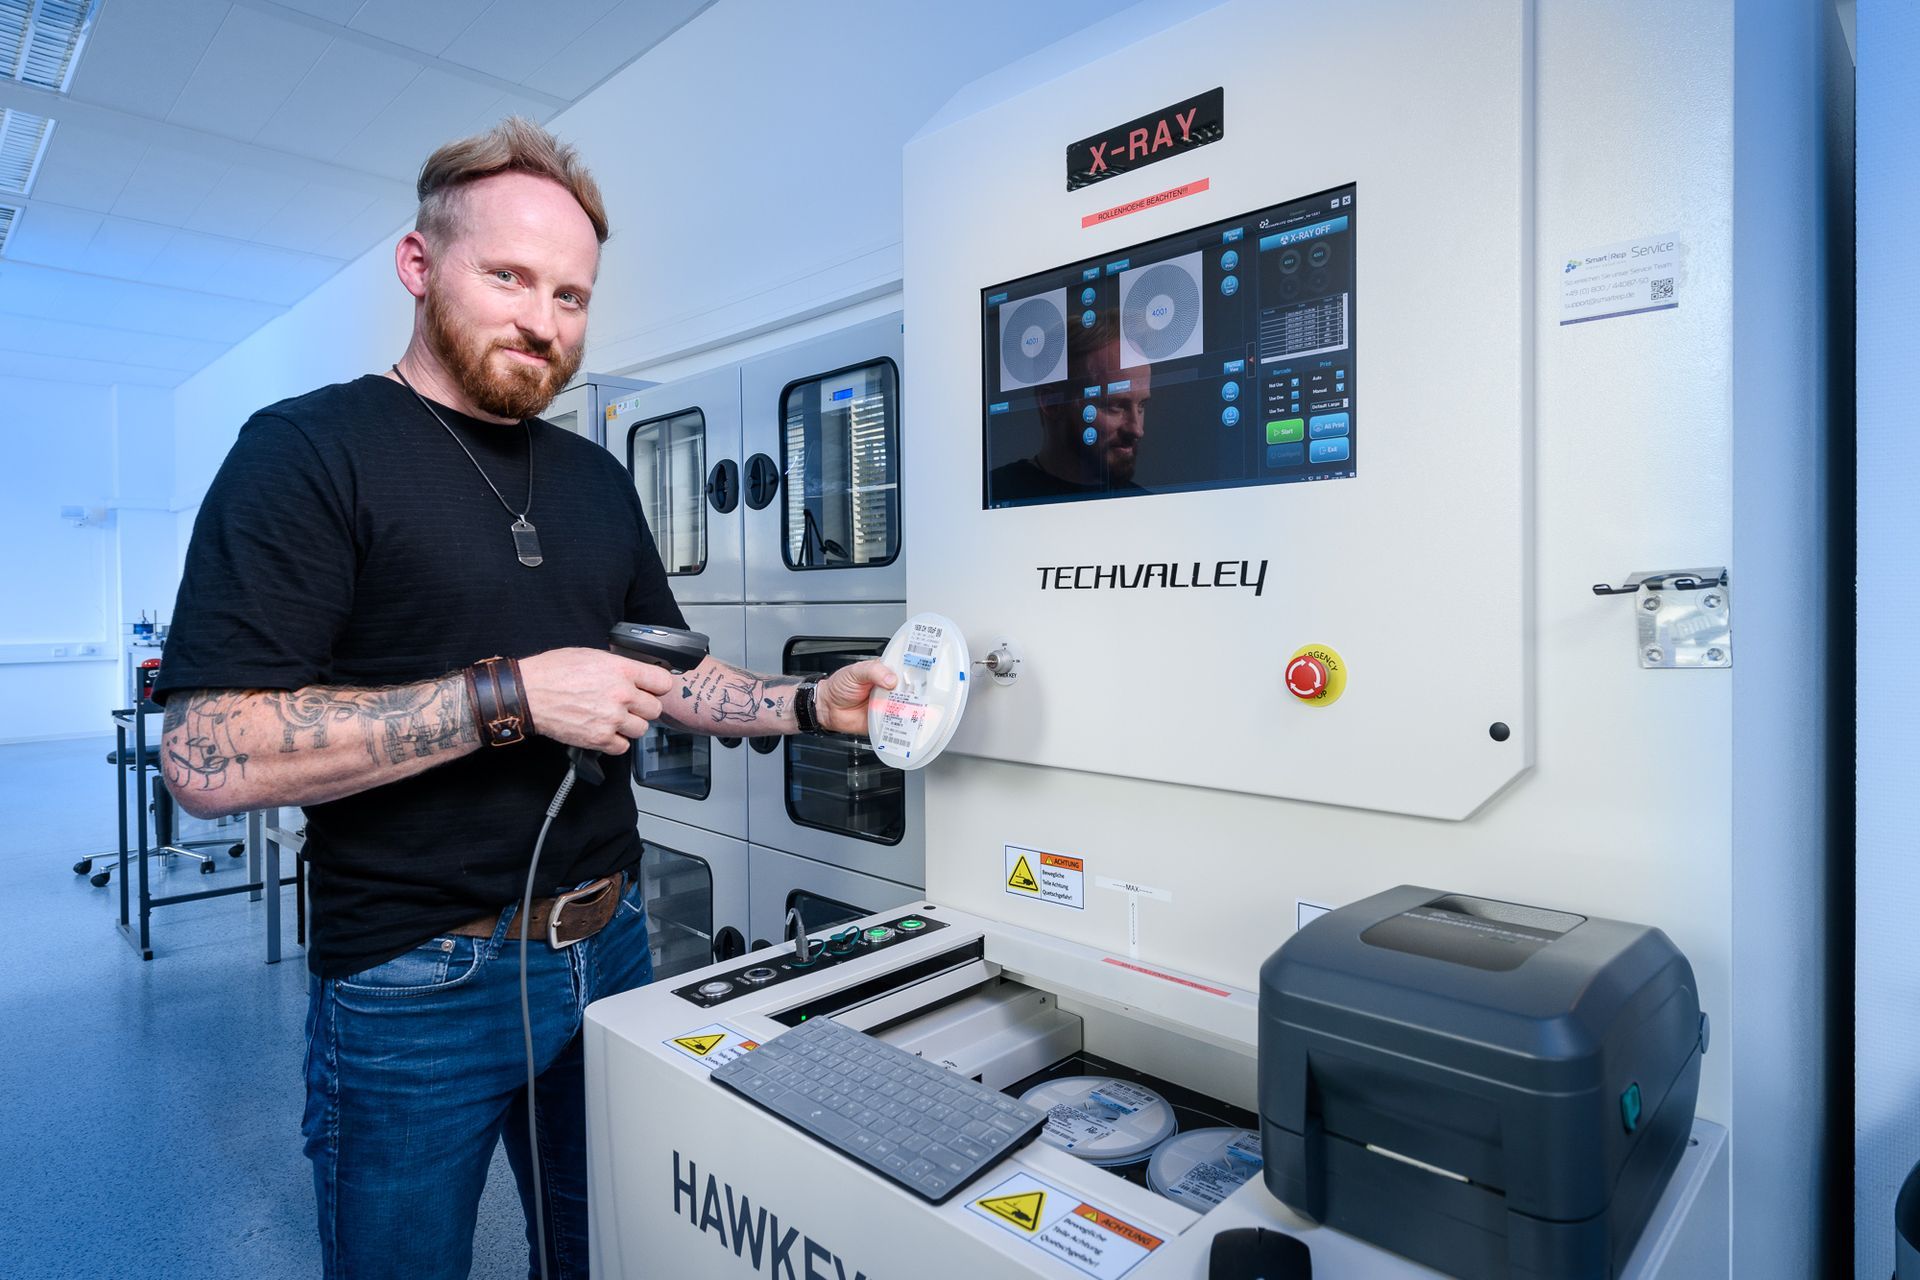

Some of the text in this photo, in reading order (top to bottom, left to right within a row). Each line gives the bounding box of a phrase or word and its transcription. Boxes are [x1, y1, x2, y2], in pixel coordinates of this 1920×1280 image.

[1089, 107, 1197, 176] X-RAY
[1098, 187, 1189, 221] ROLLENHOEHE BEACHTEN!!!
[1290, 224, 1331, 243] X-RAY OFF
[1585, 241, 1674, 265] Smart Rep Service
[1025, 307, 1168, 346] 4001 4001
[1036, 559, 1268, 597] TECHVALLEY
[1303, 650, 1338, 672] RGENCY
[1042, 869, 1065, 879] Bewegliche
[1053, 858, 1080, 869] ACHTUNG
[1052, 882, 1069, 891] Achtung
[1125, 883, 1140, 893] MAX
[1101, 1217, 1152, 1246] ACHTUNG
